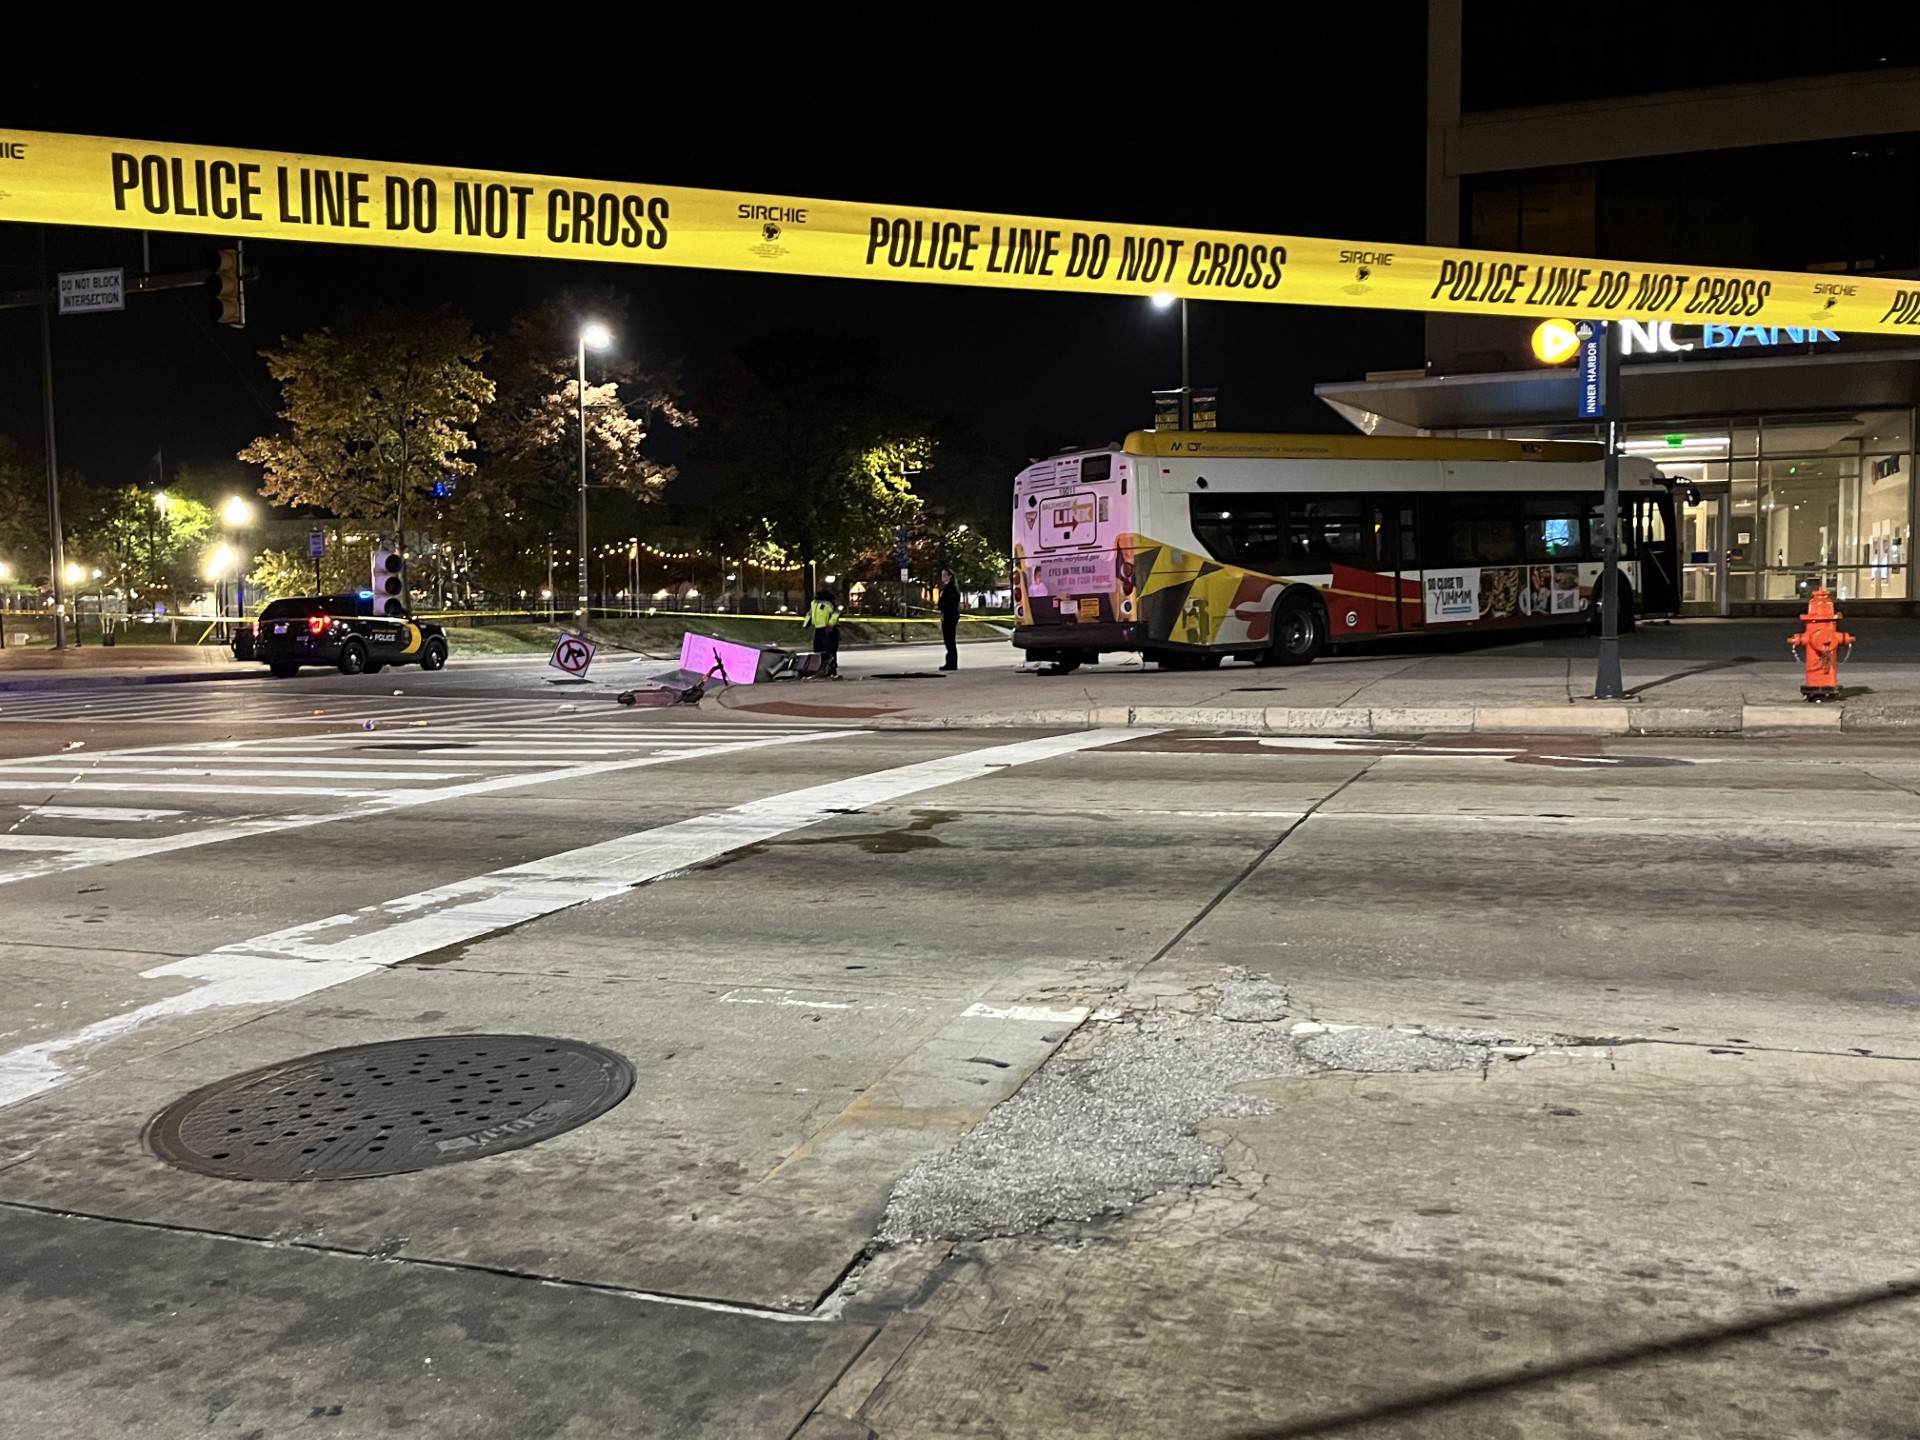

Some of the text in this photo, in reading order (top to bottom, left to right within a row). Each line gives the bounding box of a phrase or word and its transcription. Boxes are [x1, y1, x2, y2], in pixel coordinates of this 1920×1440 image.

[111, 151, 670, 250] POLICE LINE DO NOT CROSS
[738, 204, 809, 224] SIRCHIE
[865, 216, 1287, 290] POLICE LINE DO NOT CROSS
[1339, 250, 1395, 266] SIRCHIE
[61, 275, 120, 291] DO NOT BLOCK
[1430, 259, 1772, 317] POLICE LINE DO NOT CROSS
[1813, 283, 1859, 297] SIRCHIE
[63, 291, 119, 307] INTERSECTION
[1601, 318, 1694, 355] NC
[1586, 342, 1597, 413] INNER HARBOR
[1048, 565, 1096, 577] EYES ON THE ROAD
[1092, 574, 1111, 584] PHONE
[1428, 576, 1464, 590] SO CLOSE TO
[374, 633, 396, 642] POLICE
